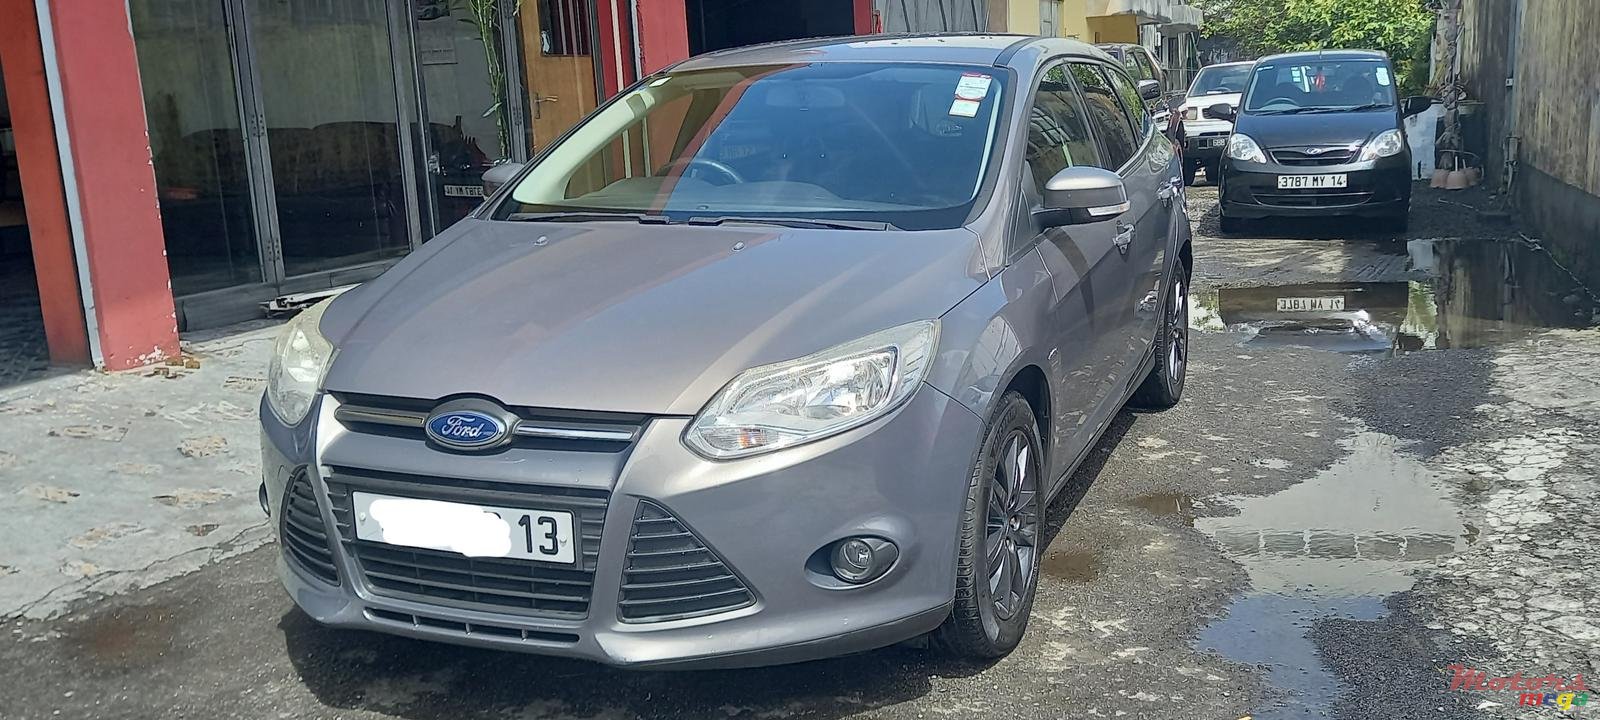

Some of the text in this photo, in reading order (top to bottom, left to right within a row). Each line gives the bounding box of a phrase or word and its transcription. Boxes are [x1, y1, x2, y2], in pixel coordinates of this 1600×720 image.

[1281, 175, 1343, 187] 3787 MY 14
[441, 415, 485, 438] Ford
[518, 514, 559, 556] 13
